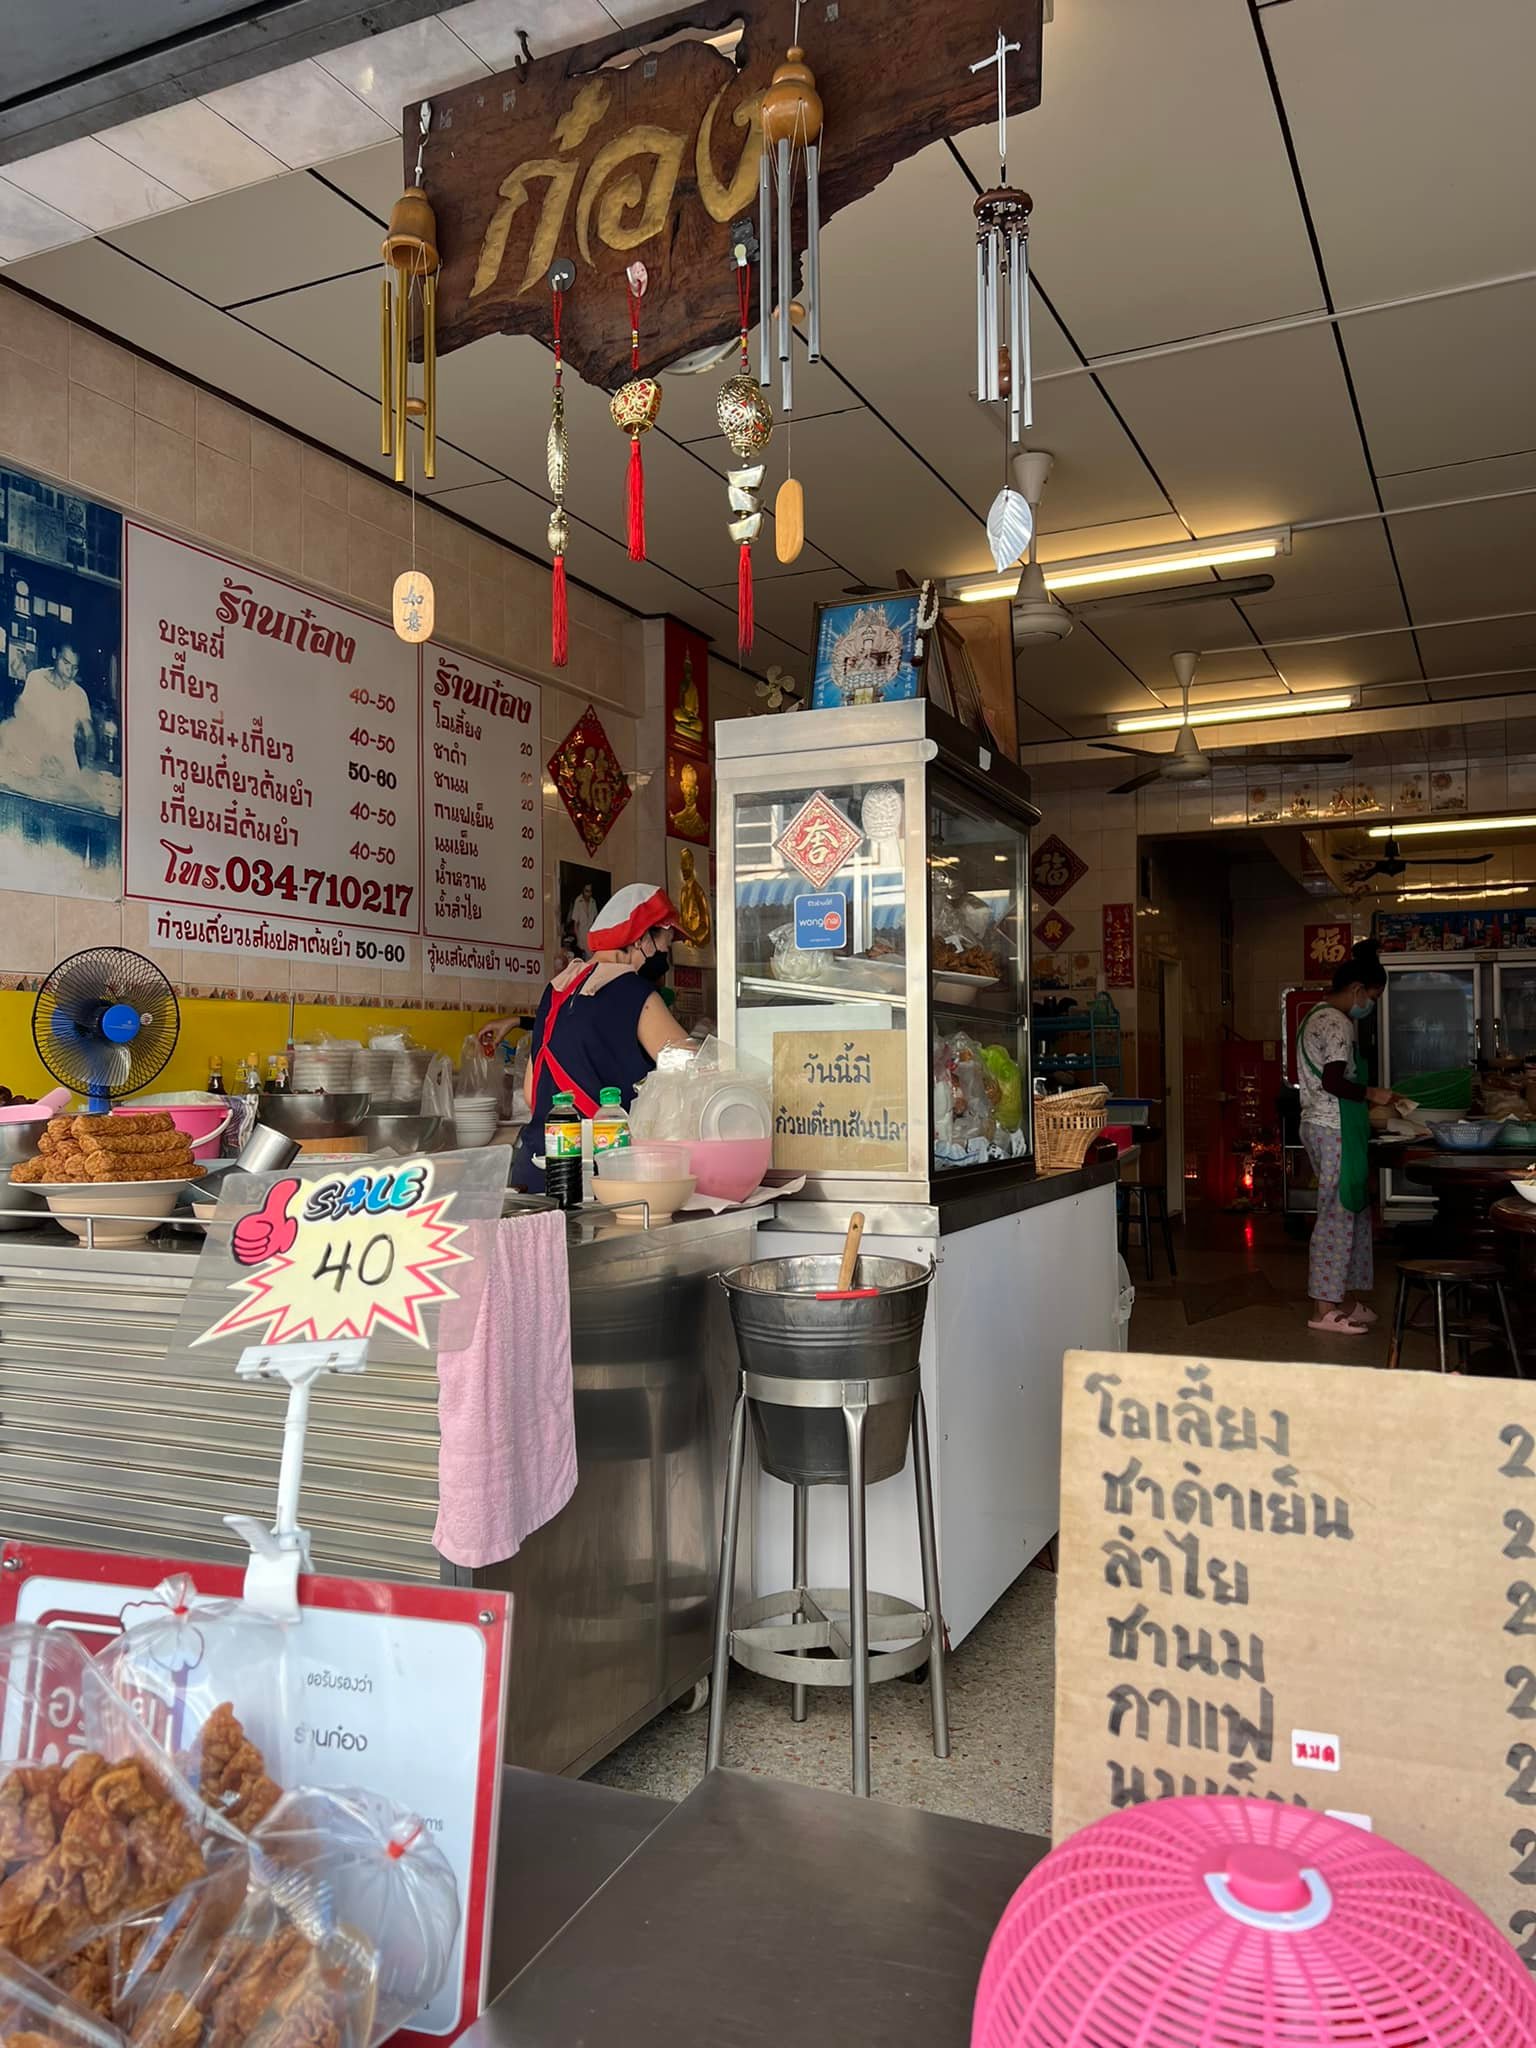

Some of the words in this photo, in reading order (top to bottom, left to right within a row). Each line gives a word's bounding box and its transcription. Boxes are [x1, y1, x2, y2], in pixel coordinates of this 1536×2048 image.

[216, 577, 357, 665] ร้านก๋อง
[158, 619, 225, 659] บะหมี่
[349, 688, 396, 713] 40-50
[433, 657, 533, 724] ร้านก๋อง
[159, 651, 219, 703] เกี๊ยว
[349, 727, 396, 753] 40-50
[433, 700, 482, 741] โอเลี้ยง
[520, 742, 533, 757] 20
[158, 709, 294, 763] บะหมี่+เกี๊ยว
[348, 761, 397, 789] 50-60
[433, 742, 467, 766] ชาดำ
[520, 771, 533, 785] 20
[159, 747, 313, 808] ก๋วยเตี๋ยวต้มยำ
[349, 801, 397, 827] 40-50
[433, 771, 469, 794] ชานม
[521, 799, 534, 812] 20
[159, 783, 299, 846] เกี๊ยมอี๋ต้มยำ
[349, 841, 396, 865] 40-50
[434, 802, 494, 831] กาแฟเย็น
[521, 826, 534, 840] 20
[434, 829, 479, 857] นมเย็น
[521, 856, 535, 870] 20
[435, 857, 487, 892] น้ำหวาน
[522, 886, 535, 900] 20
[157, 910, 350, 957] ก๋วยเตี๋ยวเส้นปลาต้มยำ
[354, 941, 406, 963] 50-60
[435, 889, 482, 920] น้ำลำไย
[522, 916, 535, 929] 20
[504, 957, 541, 976] 40-50
[803, 1042, 872, 1083] วันนี้มี
[303, 1166, 428, 1222] SALE
[312, 1233, 395, 1293] 40
[1084, 1363, 1290, 1457] โอเลี้ยง
[1101, 1525, 1249, 1605] ลำไย
[1106, 1602, 1266, 1683] ชานม
[1106, 1683, 1274, 1763] กาแฟ
